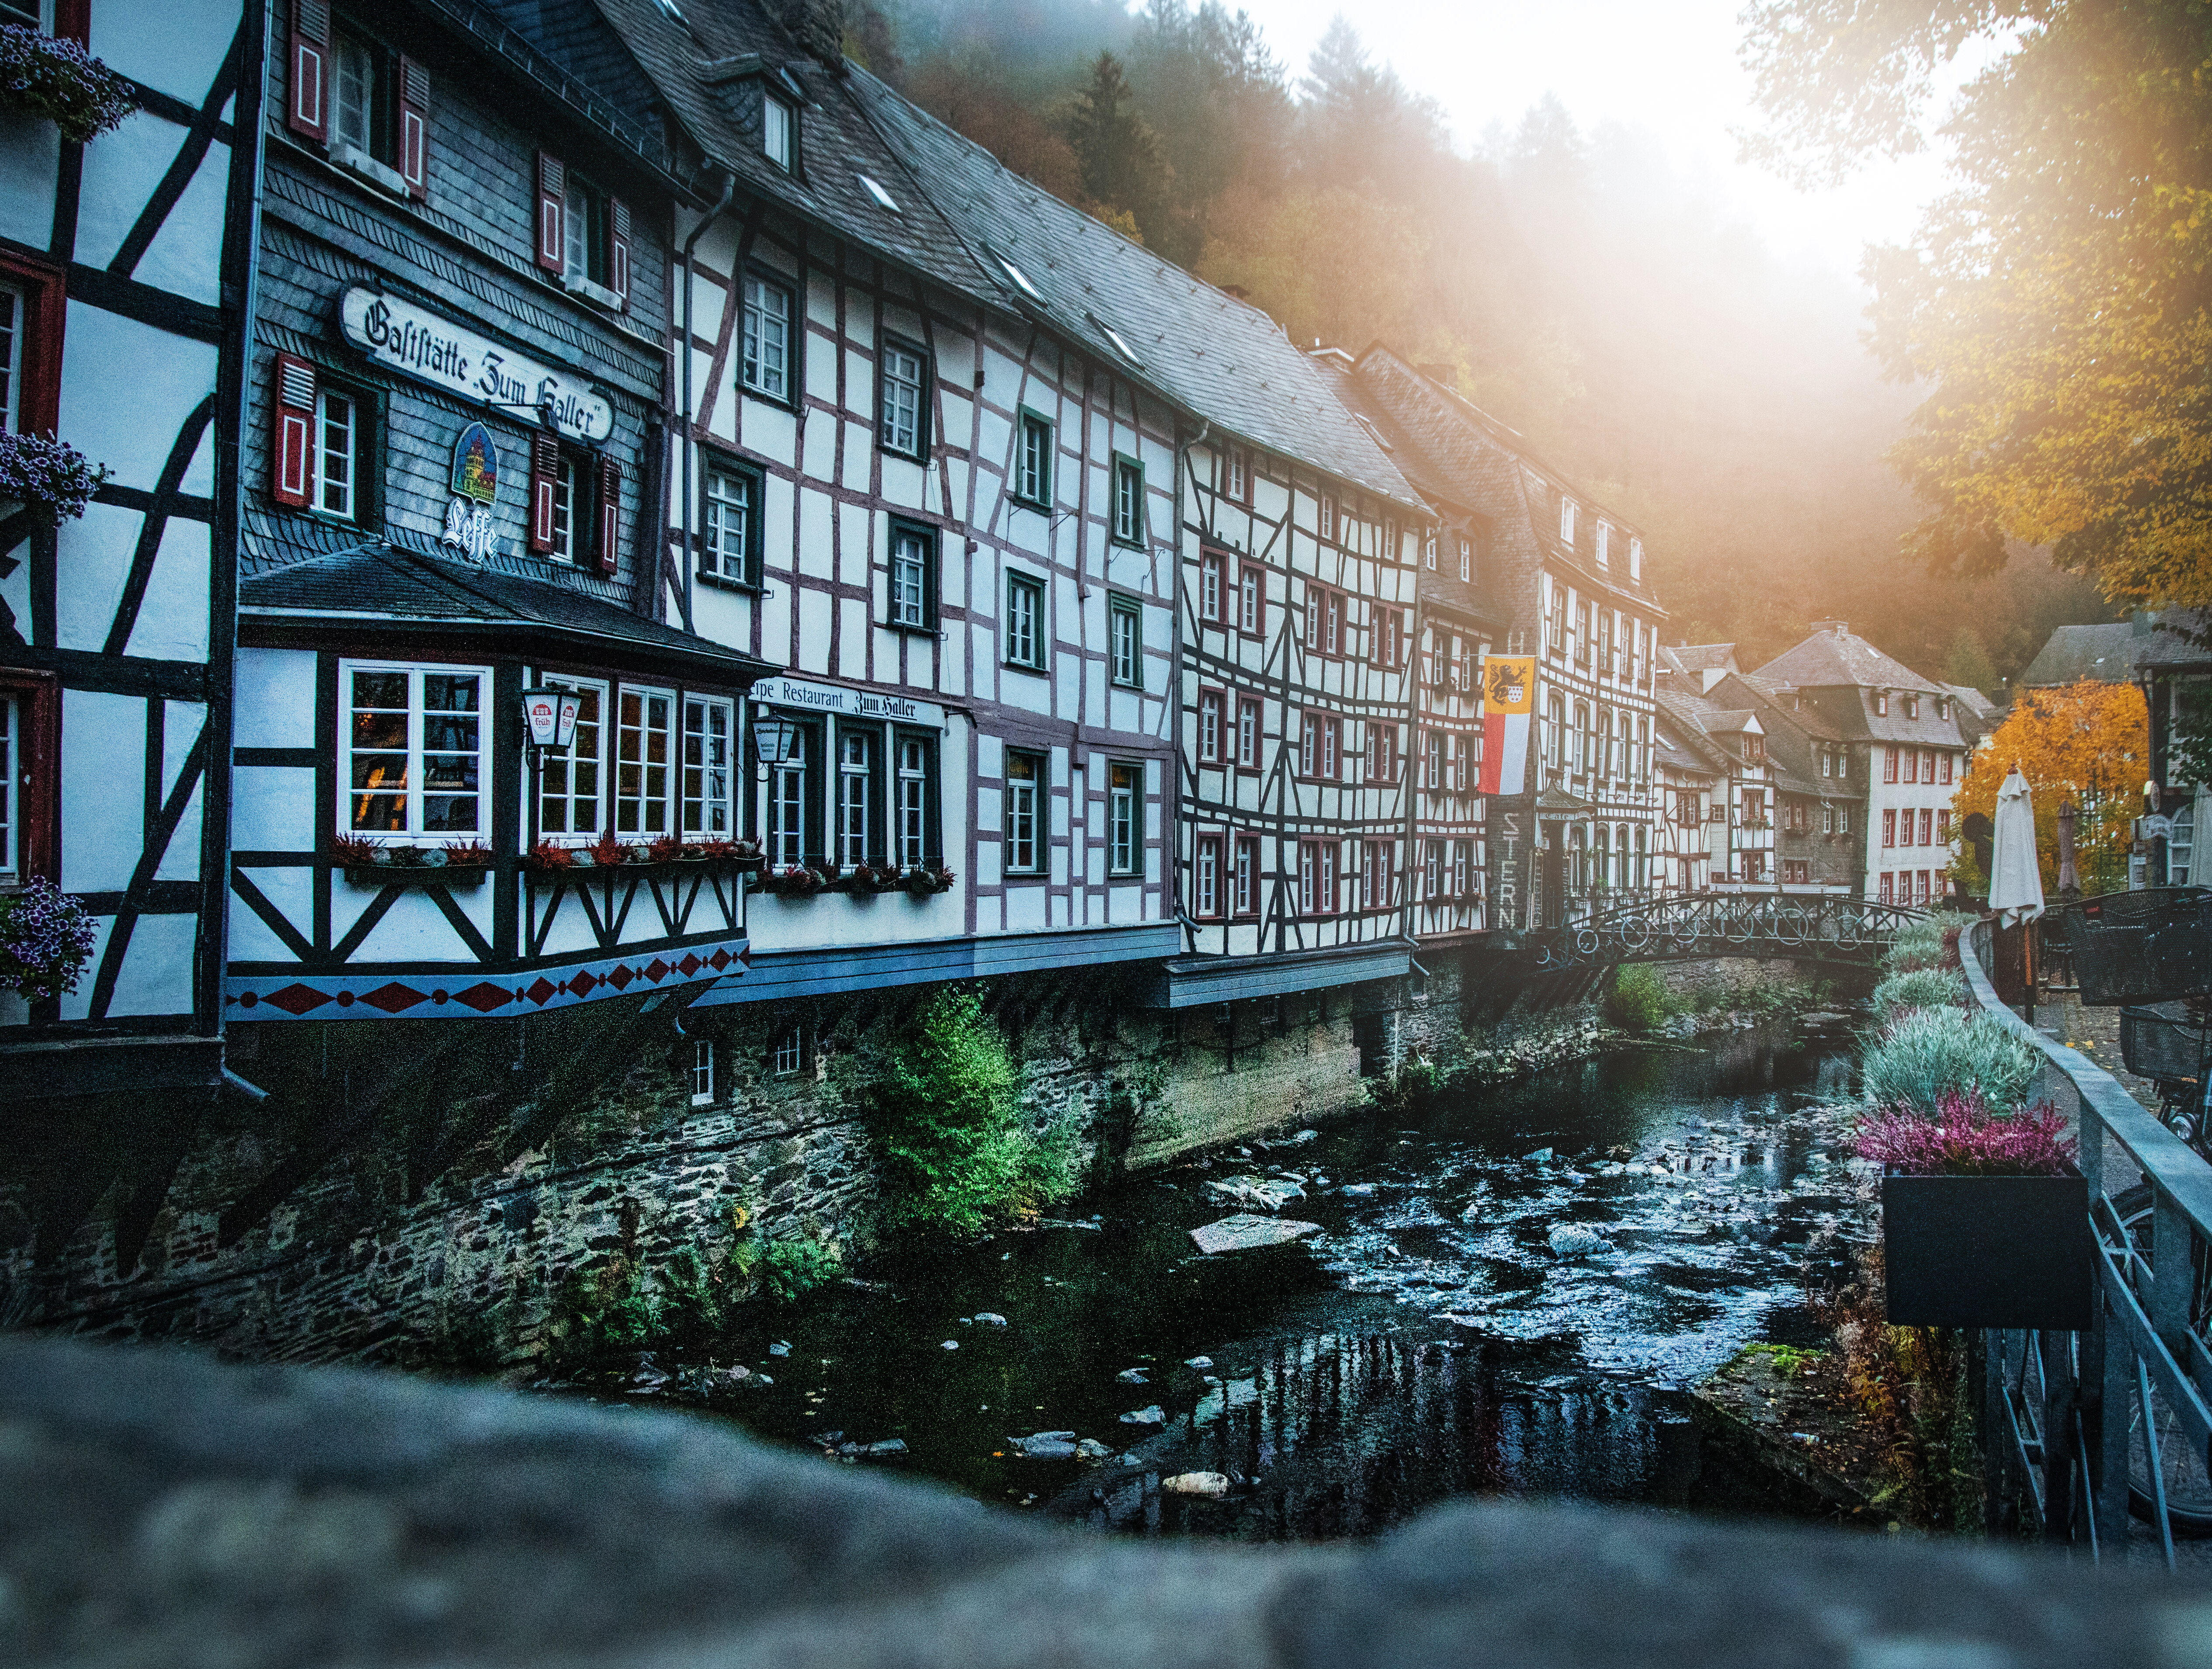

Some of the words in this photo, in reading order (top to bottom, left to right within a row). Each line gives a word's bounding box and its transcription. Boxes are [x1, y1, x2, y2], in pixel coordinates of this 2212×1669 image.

[442, 497, 498, 562] Leffe
[783, 682, 843, 708] Restaurant
[853, 691, 879, 715] Zum
[882, 696, 916, 717] Haller
[1499, 813, 1519, 929] STERN
